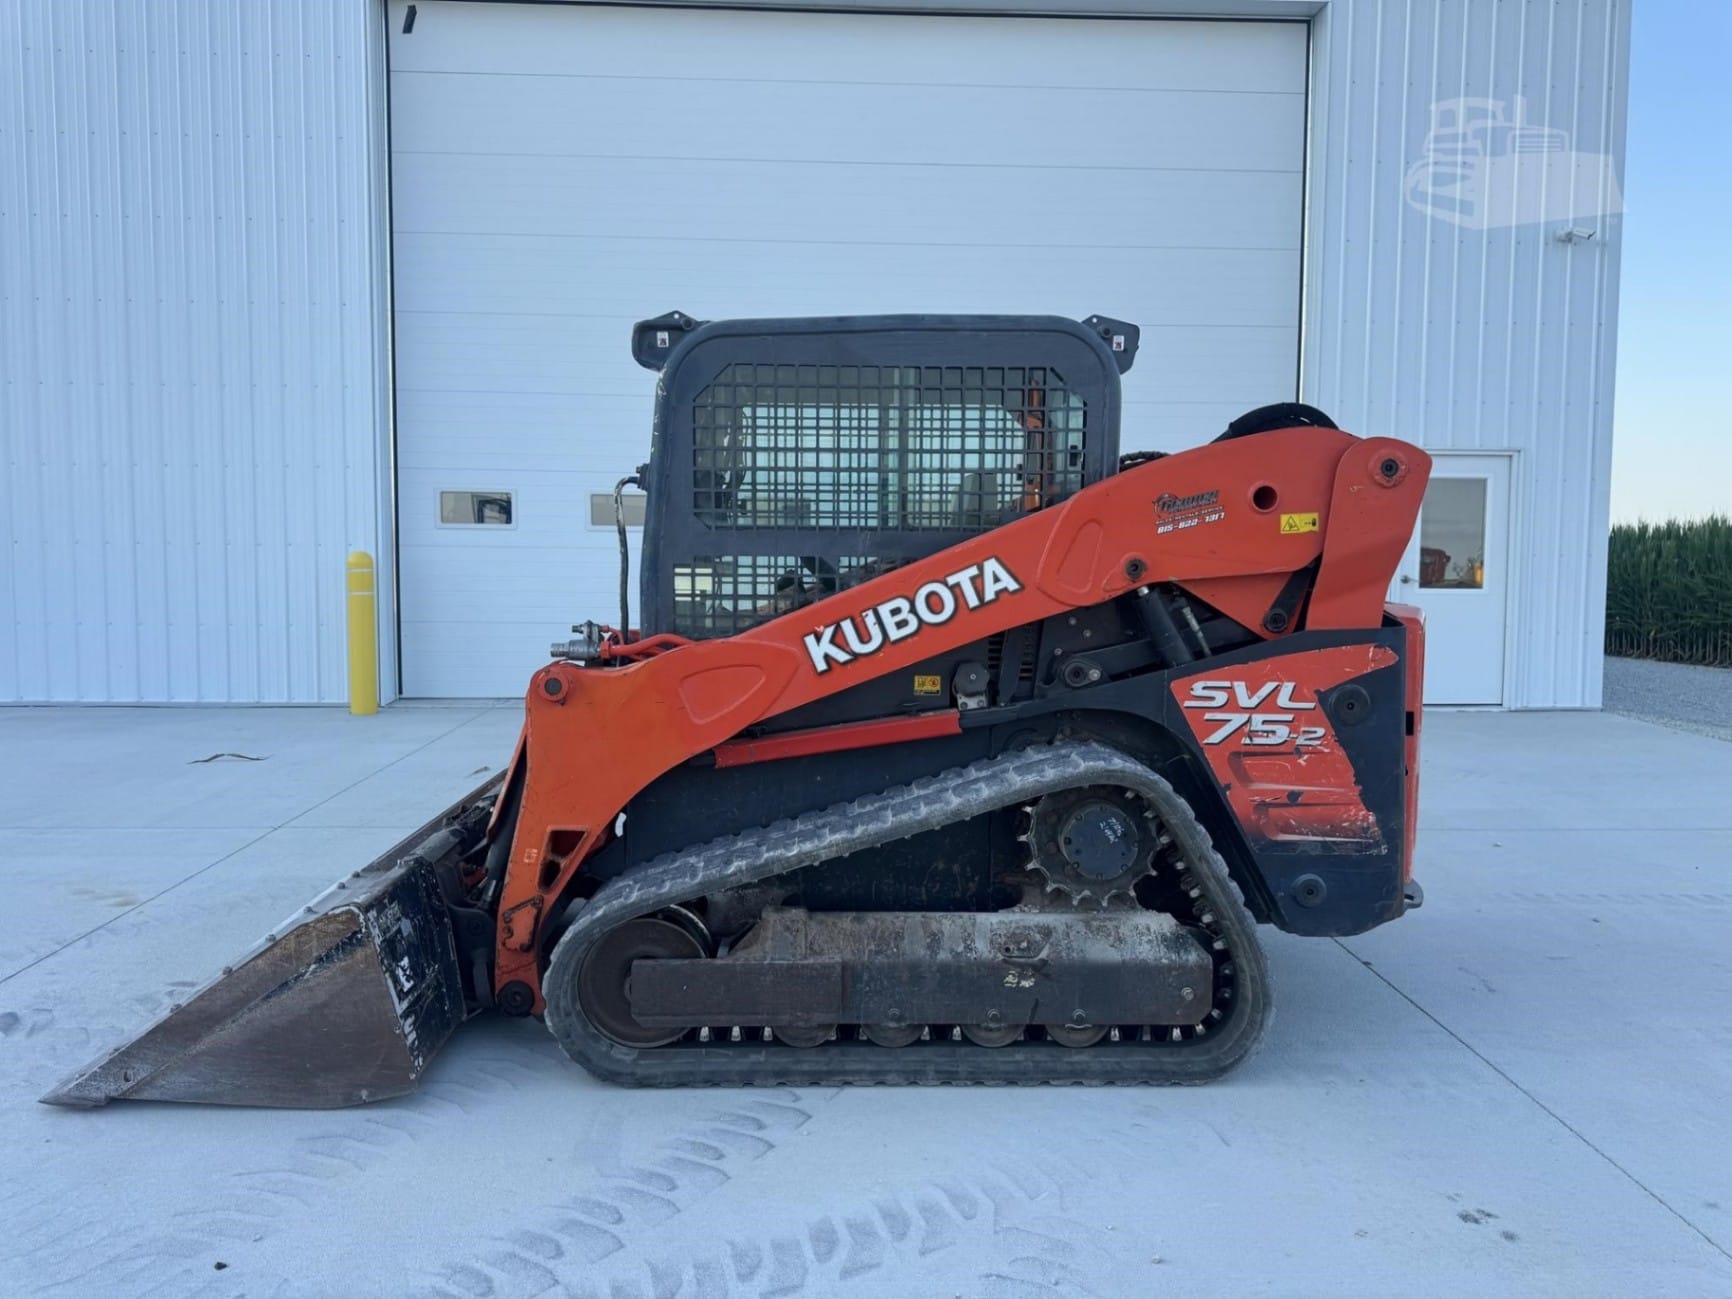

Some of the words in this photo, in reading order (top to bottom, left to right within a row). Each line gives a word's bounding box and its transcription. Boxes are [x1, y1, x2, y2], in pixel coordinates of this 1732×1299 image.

[803, 556, 1023, 673] KUBOTA
[1183, 680, 1317, 710] SVL
[1202, 712, 1326, 746] 75-2
